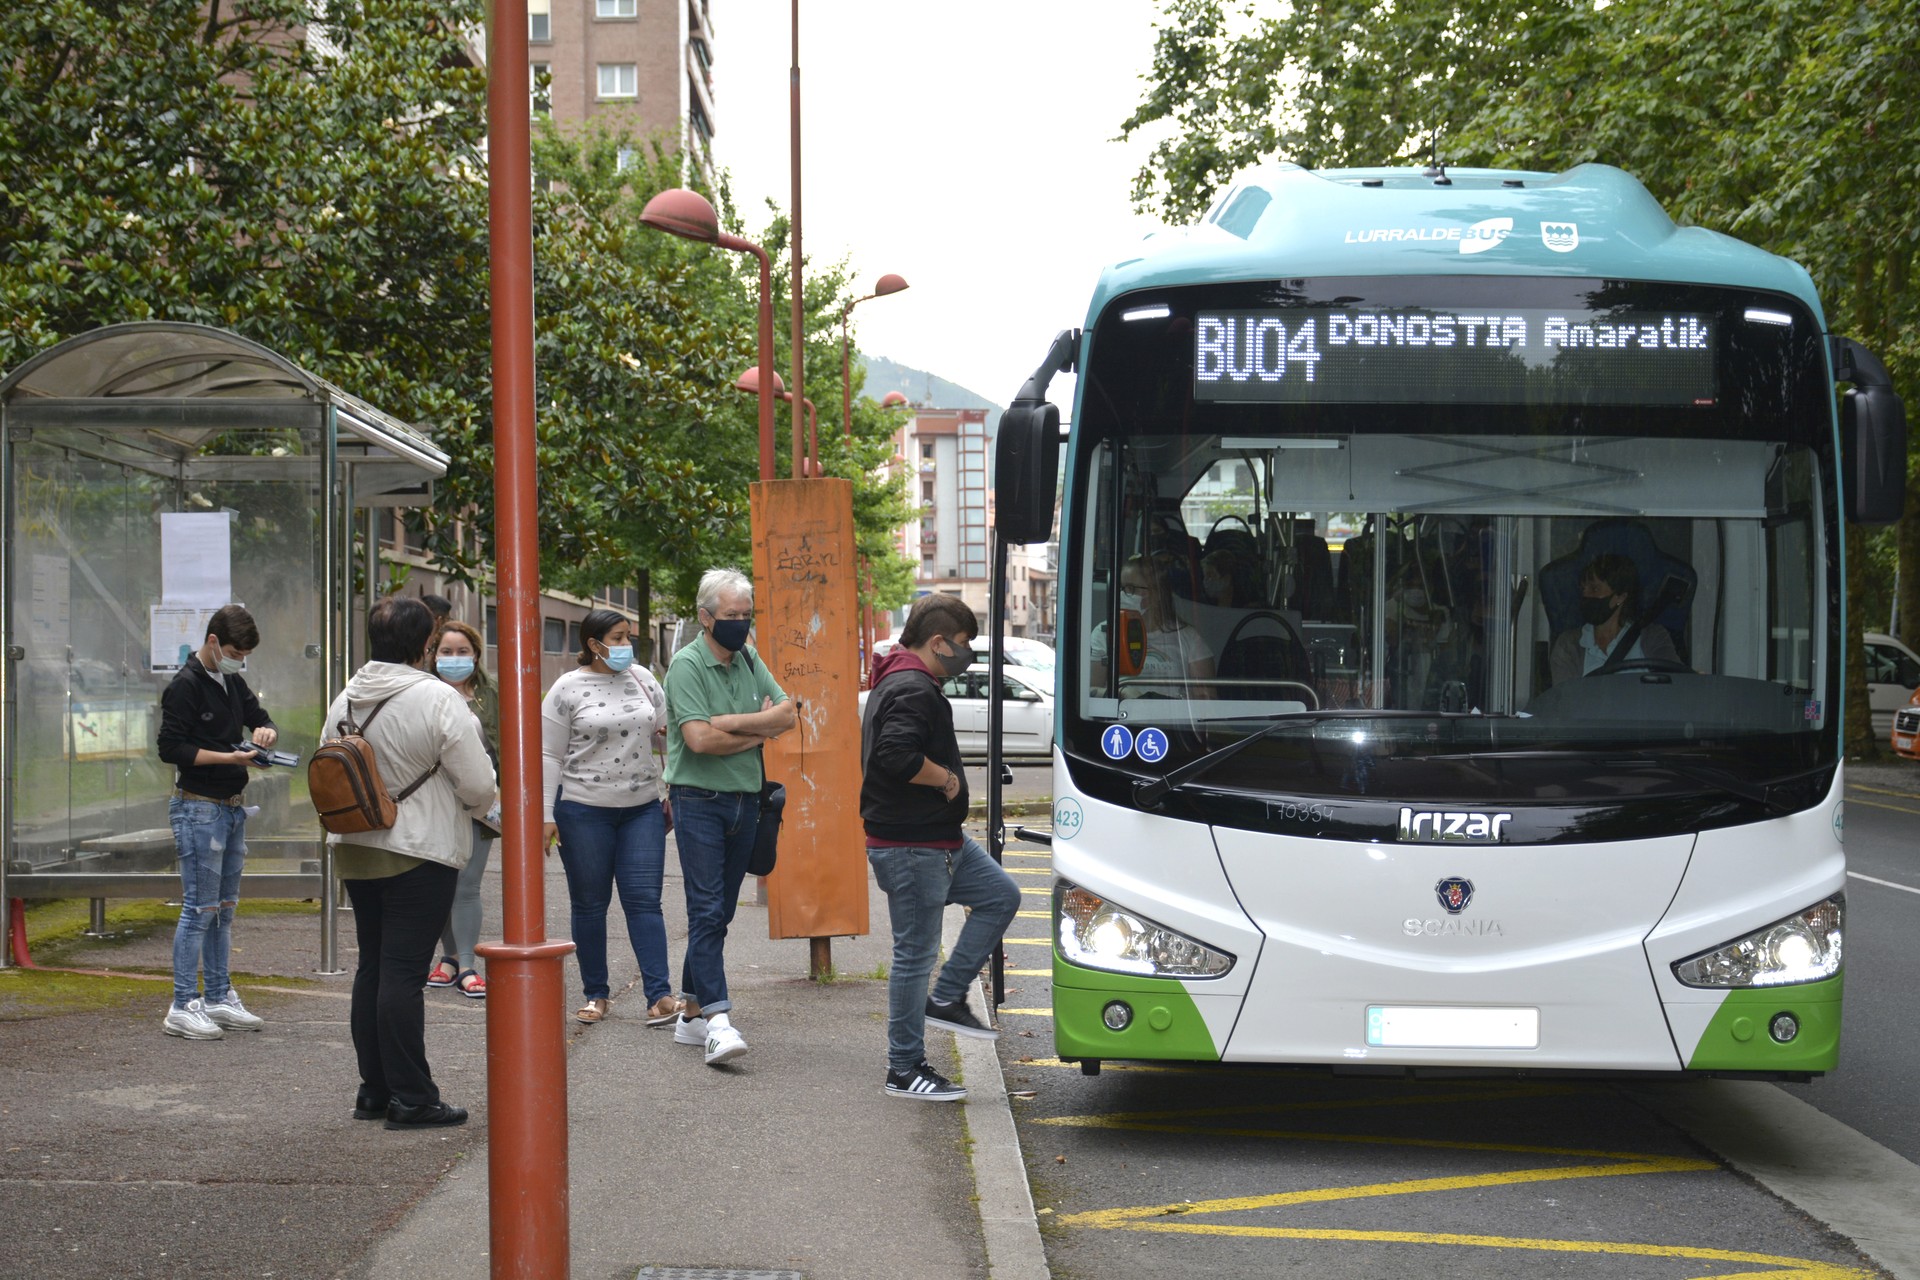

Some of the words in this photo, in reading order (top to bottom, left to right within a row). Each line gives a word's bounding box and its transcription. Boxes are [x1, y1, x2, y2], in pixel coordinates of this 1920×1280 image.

[1344, 228, 1461, 244] LURRALDE
[1465, 228, 1512, 240] BUS
[1197, 317, 1322, 382] BU04
[1328, 314, 1527, 347] DONOSTIA
[1544, 316, 1708, 348] Amaratik
[1056, 810, 1080, 828] 423
[1402, 918, 1505, 937] SCANIA
